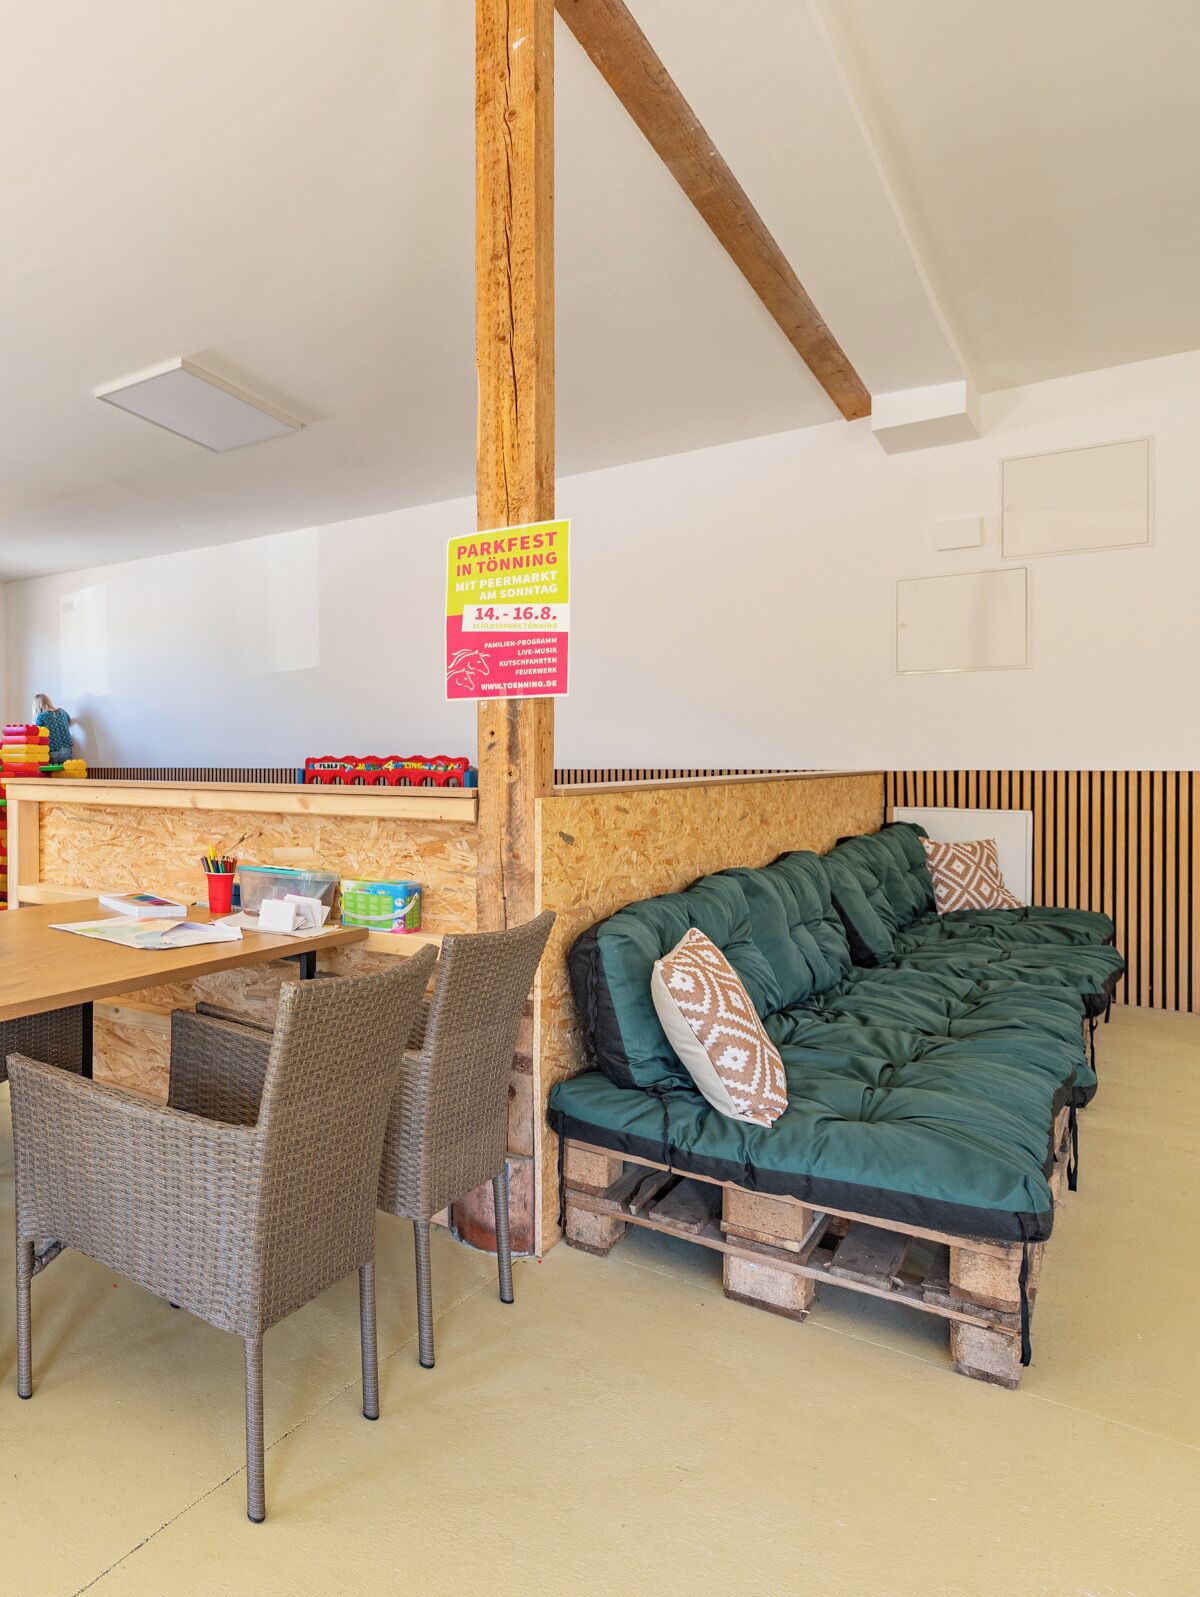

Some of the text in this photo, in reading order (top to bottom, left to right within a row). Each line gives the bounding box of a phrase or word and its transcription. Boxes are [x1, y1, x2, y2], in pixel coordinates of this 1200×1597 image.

[456, 532, 558, 560] PARKFEST
[456, 552, 557, 577] IN TÖNNING
[455, 571, 558, 592] MIT PEERMARKT
[479, 584, 557, 601] AM SONNTAG
[474, 607, 500, 620] 14.
[512, 606, 557, 620] 16.8.
[484, 637, 557, 649] FAMILIEN-PROGRAMM
[517, 647, 557, 656] LIVE-MUSIK
[499, 658, 557, 667] KUTSCHFAHRTEN
[515, 667, 557, 676] FEUERWERK
[480, 680, 557, 691] WWW.TOENNING.DE
